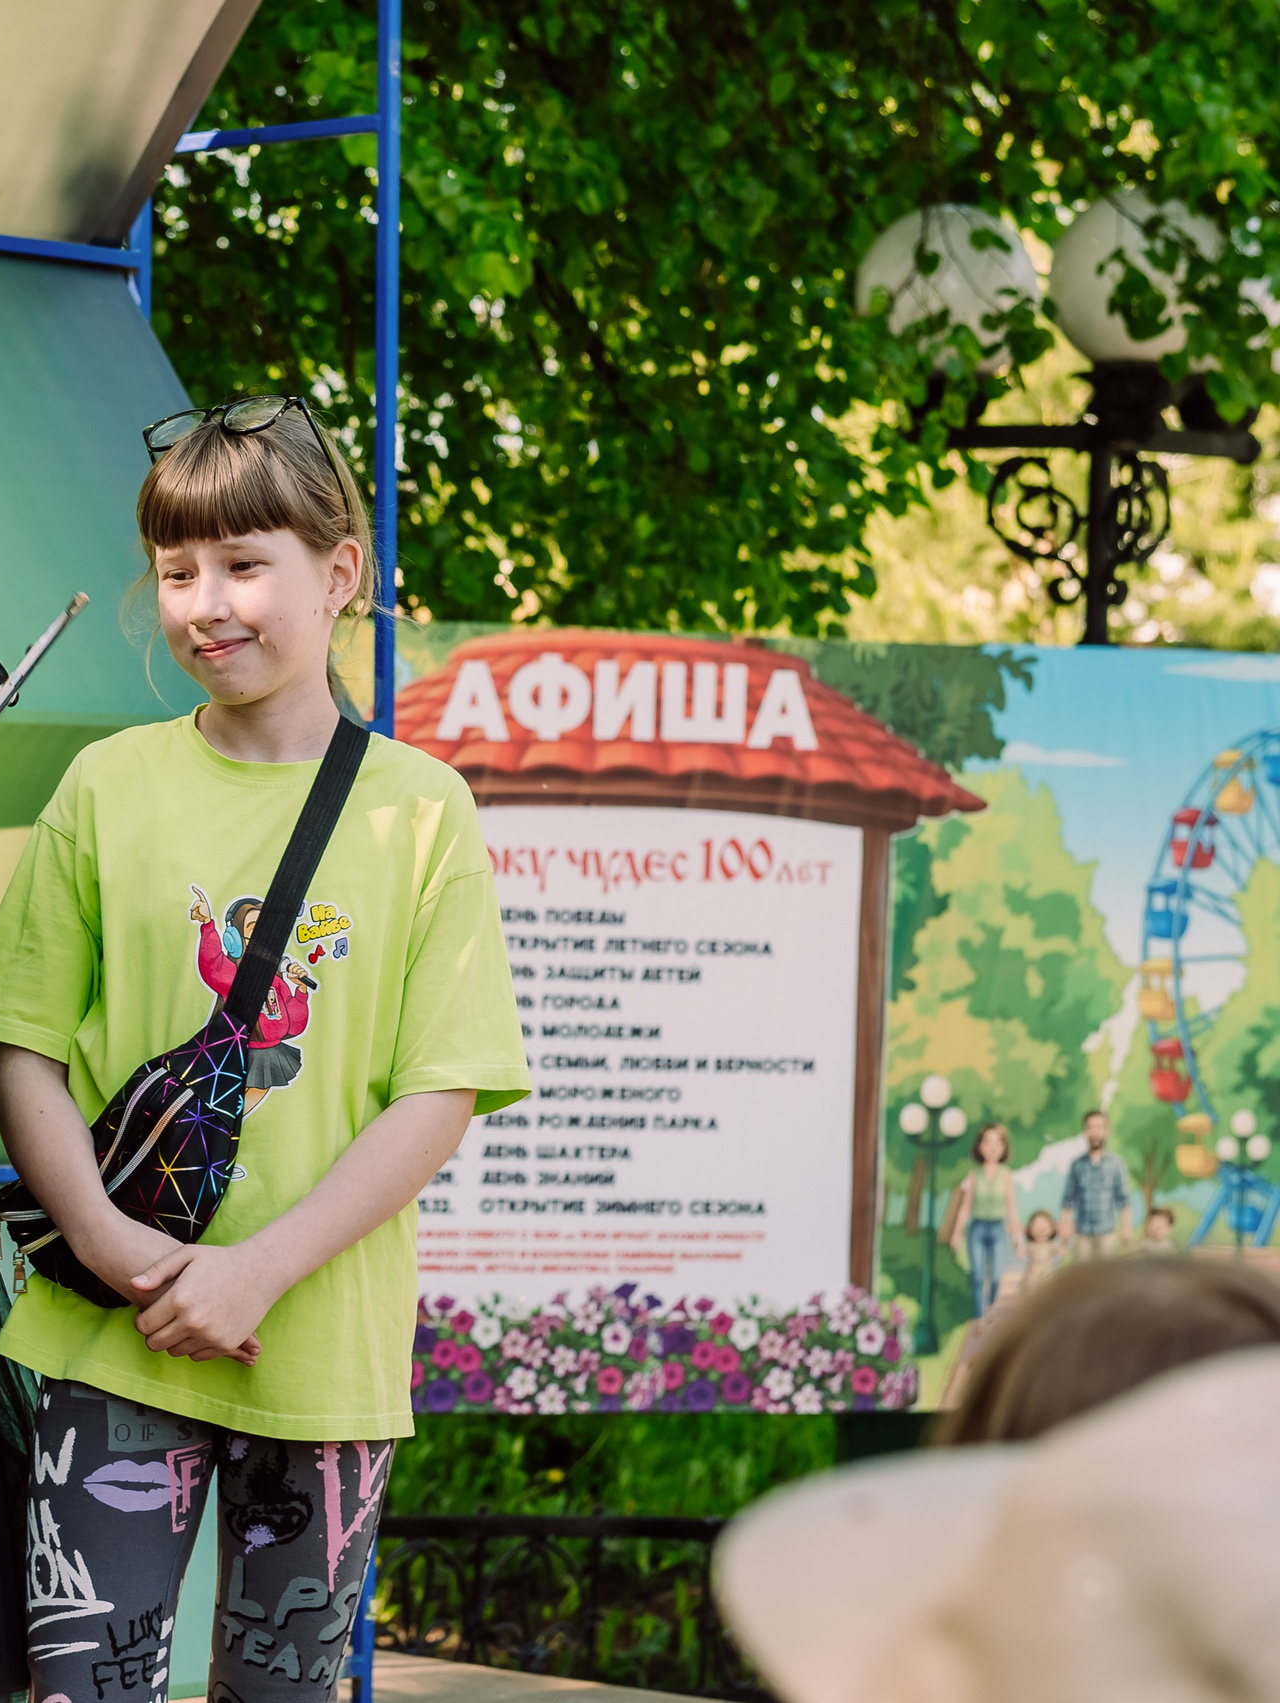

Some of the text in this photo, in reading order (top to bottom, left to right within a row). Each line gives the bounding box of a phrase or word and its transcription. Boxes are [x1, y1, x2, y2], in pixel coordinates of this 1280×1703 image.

[435, 652, 819, 751] АФИША
[566, 846, 688, 894] ЧУДЕС
[702, 836, 773, 882] 100
[545, 909, 625, 925] ПОБЕДЫ
[507, 935, 773, 956] ТКРЫТИЕ ЛЕТНЕГО СЕЗОНА
[544, 965, 633, 982] ЗАЩИТЫ
[642, 965, 701, 982] ДЕТЕЙ
[541, 995, 621, 1011] ГОРОДА
[621, 1056, 689, 1072] ЛЮБВИ
[696, 1058, 709, 1073] И
[715, 1058, 815, 1075] ВЕРНОСТИ
[539, 1086, 682, 1103] МОРОЖЕНОГО
[484, 1113, 718, 1131] ДЕНЬ РОЖДЕНИЯ ПАРКА
[483, 1144, 528, 1160] ДЕНЬ
[481, 1171, 527, 1187] ДЕНЬ
[480, 1199, 585, 1215] ОТКРЫТИЕ
[594, 1200, 683, 1216] ЗИМНЕГО
[689, 1201, 767, 1217] СЕЗОНА
[221, 1615, 342, 1690] TEAM
